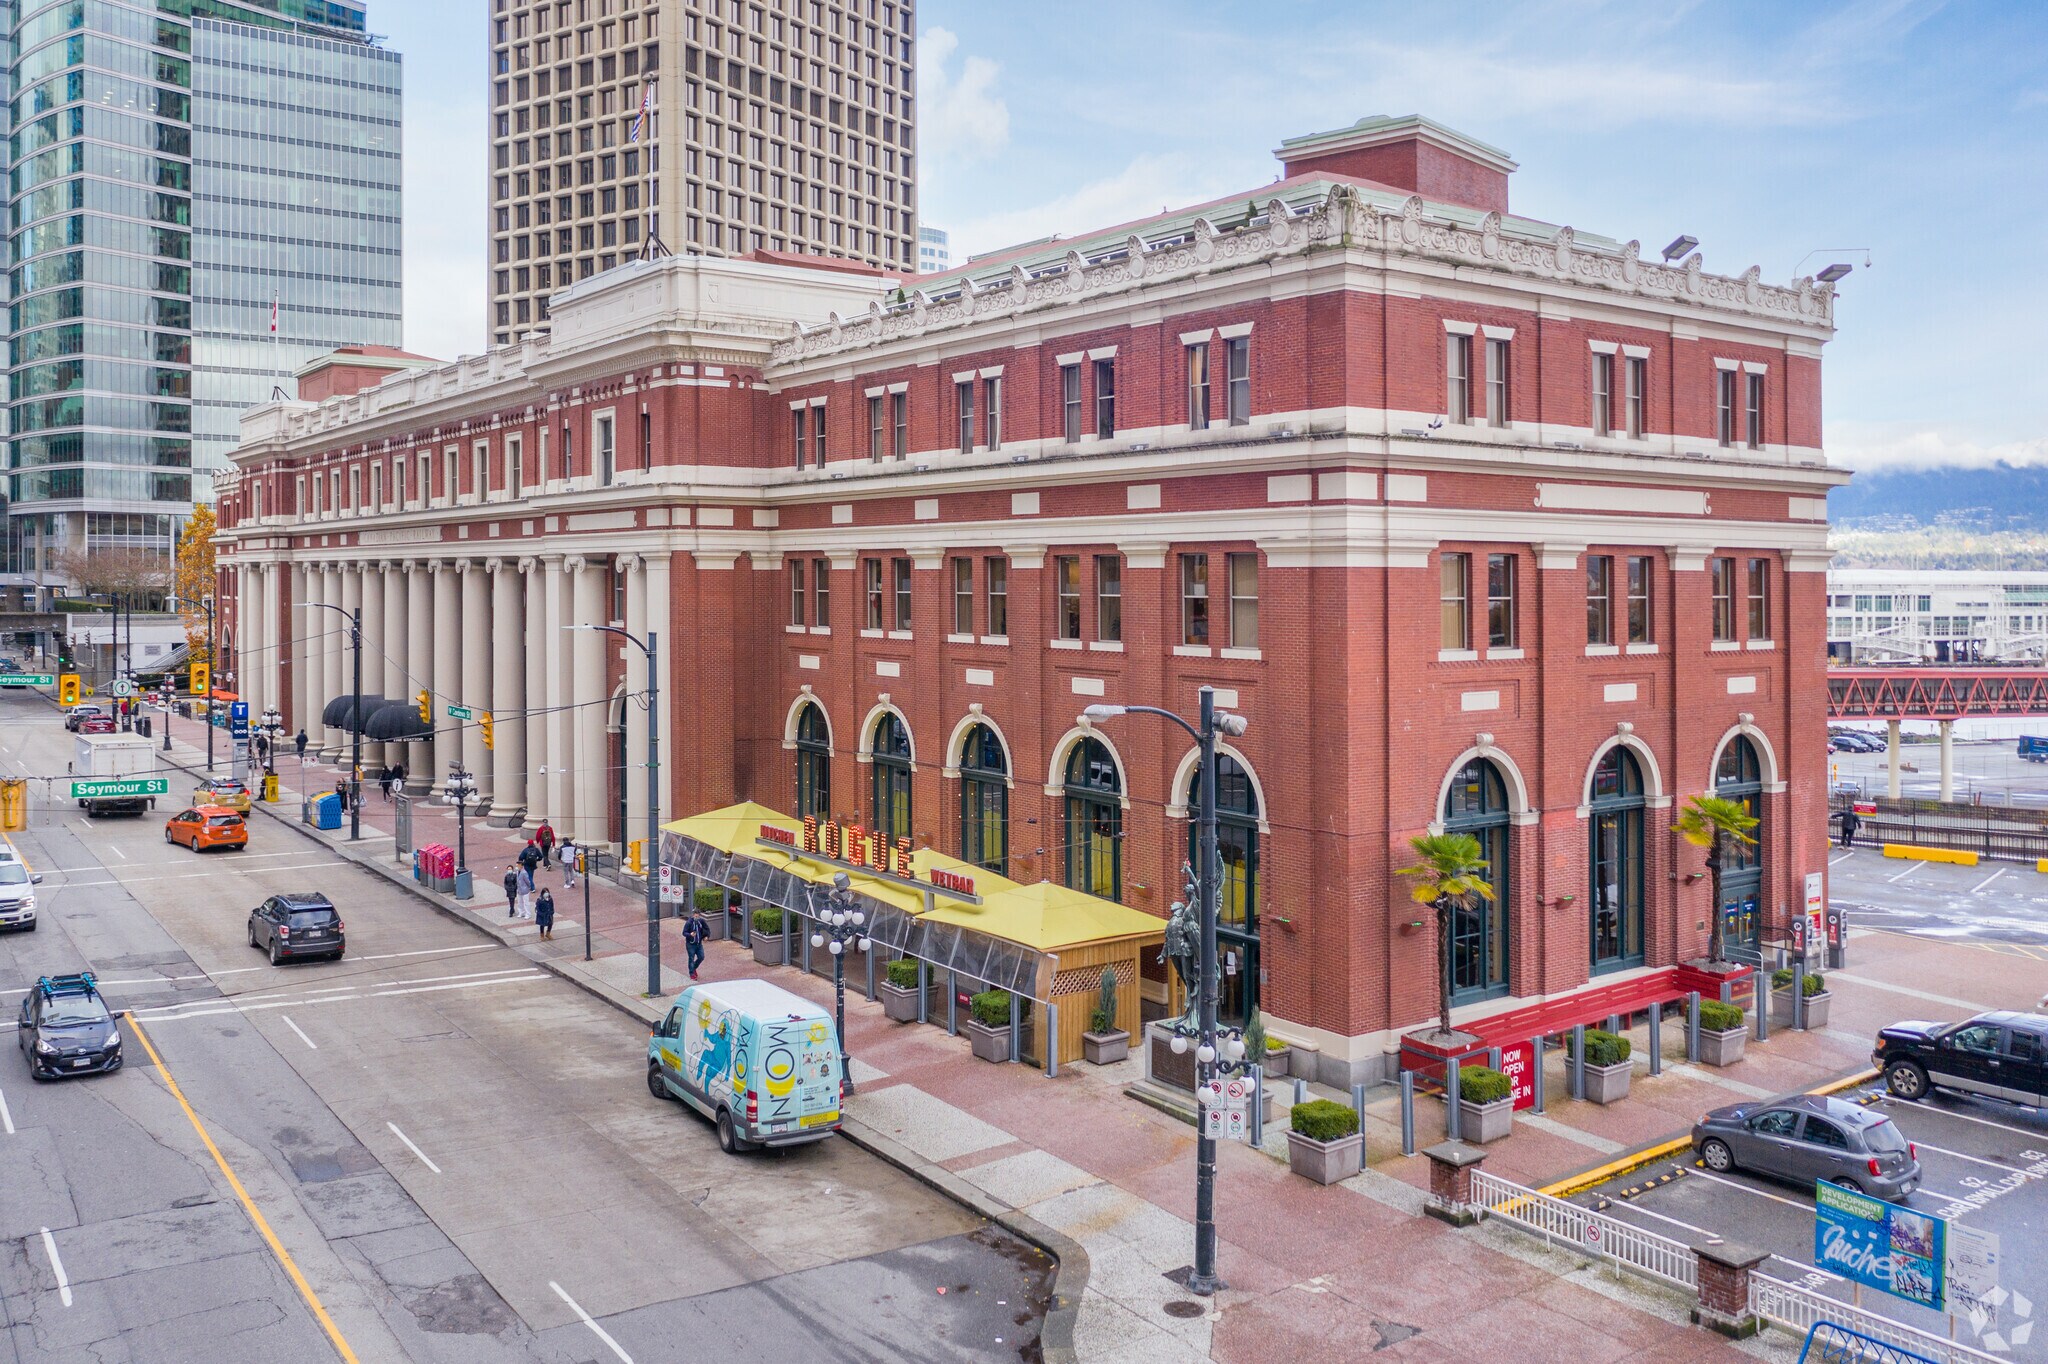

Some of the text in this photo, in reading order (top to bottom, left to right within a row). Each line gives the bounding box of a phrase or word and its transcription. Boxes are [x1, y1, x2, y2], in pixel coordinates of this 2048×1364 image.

[40, 676, 50, 684] St
[235, 704, 246, 716] T
[77, 780, 162, 796] Seymour St
[804, 814, 914, 879] ROGUE
[1503, 1049, 1521, 1064] NOW
[1502, 1061, 1524, 1076] OPEN
[1522, 1084, 1531, 1097] IN
[1958, 1176, 1989, 1188] 62
[1821, 1186, 1882, 1213] DEVELOPMENT
